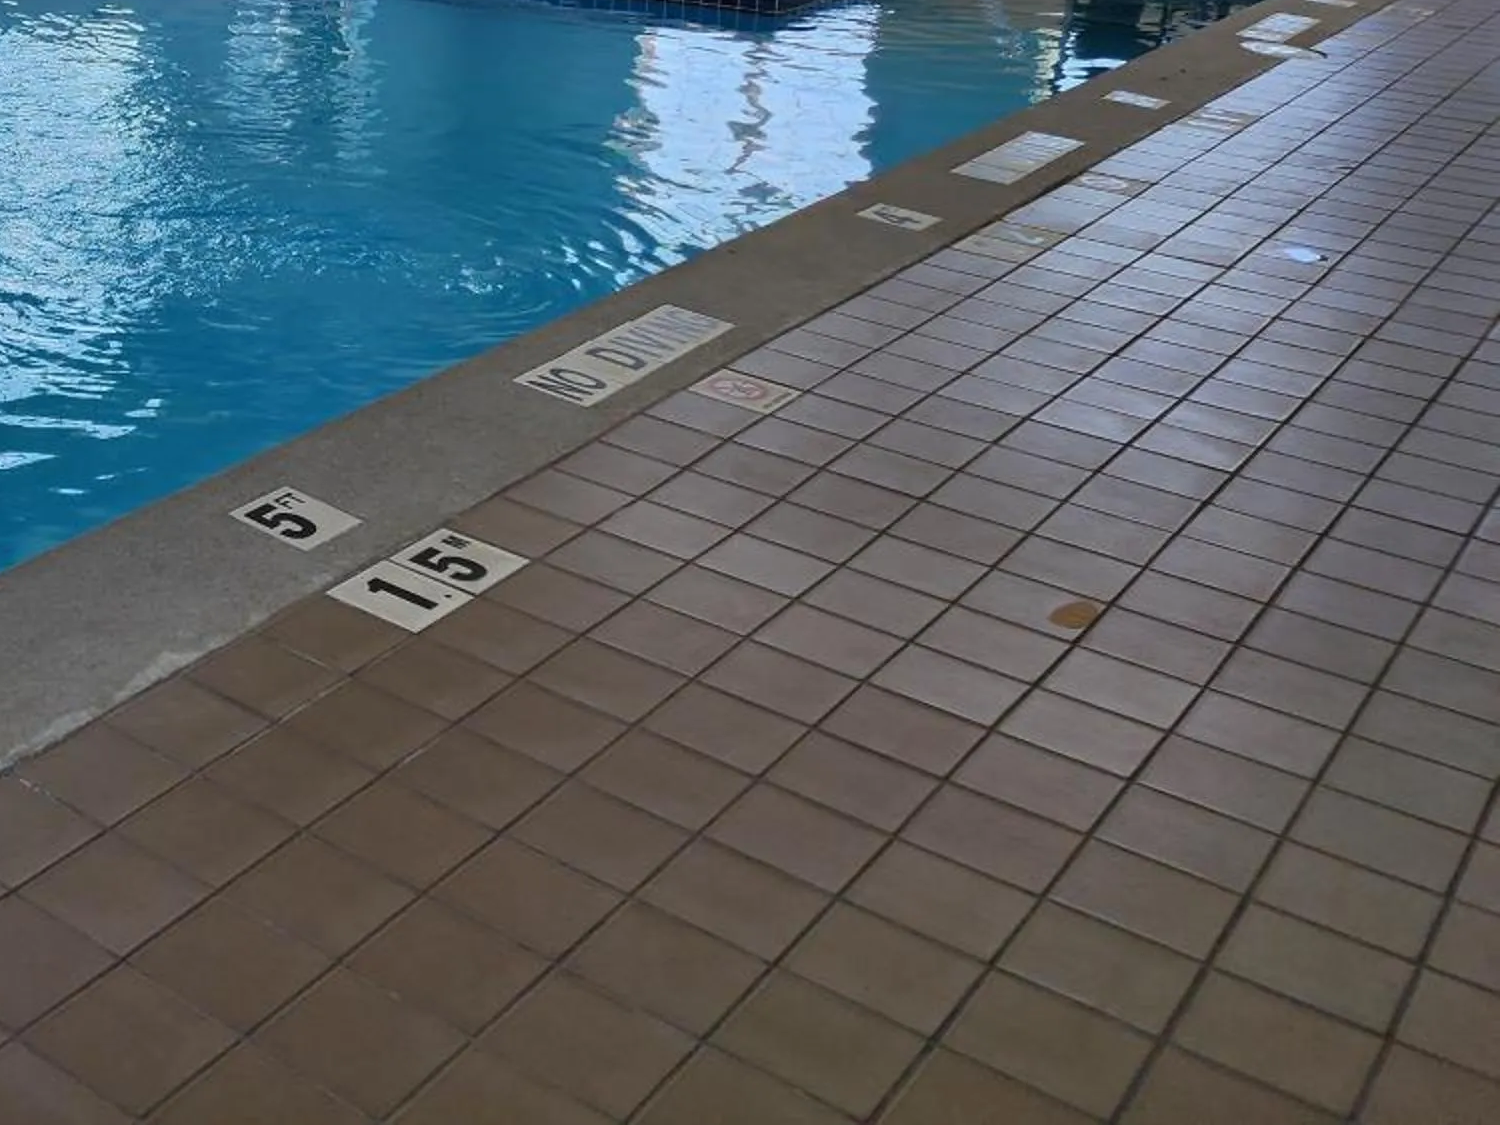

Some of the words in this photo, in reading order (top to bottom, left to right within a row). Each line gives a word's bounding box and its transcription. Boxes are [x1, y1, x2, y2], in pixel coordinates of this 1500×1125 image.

[525, 368, 607, 402] NO
[244, 503, 318, 540] 5
[365, 547, 488, 611] 1.5
